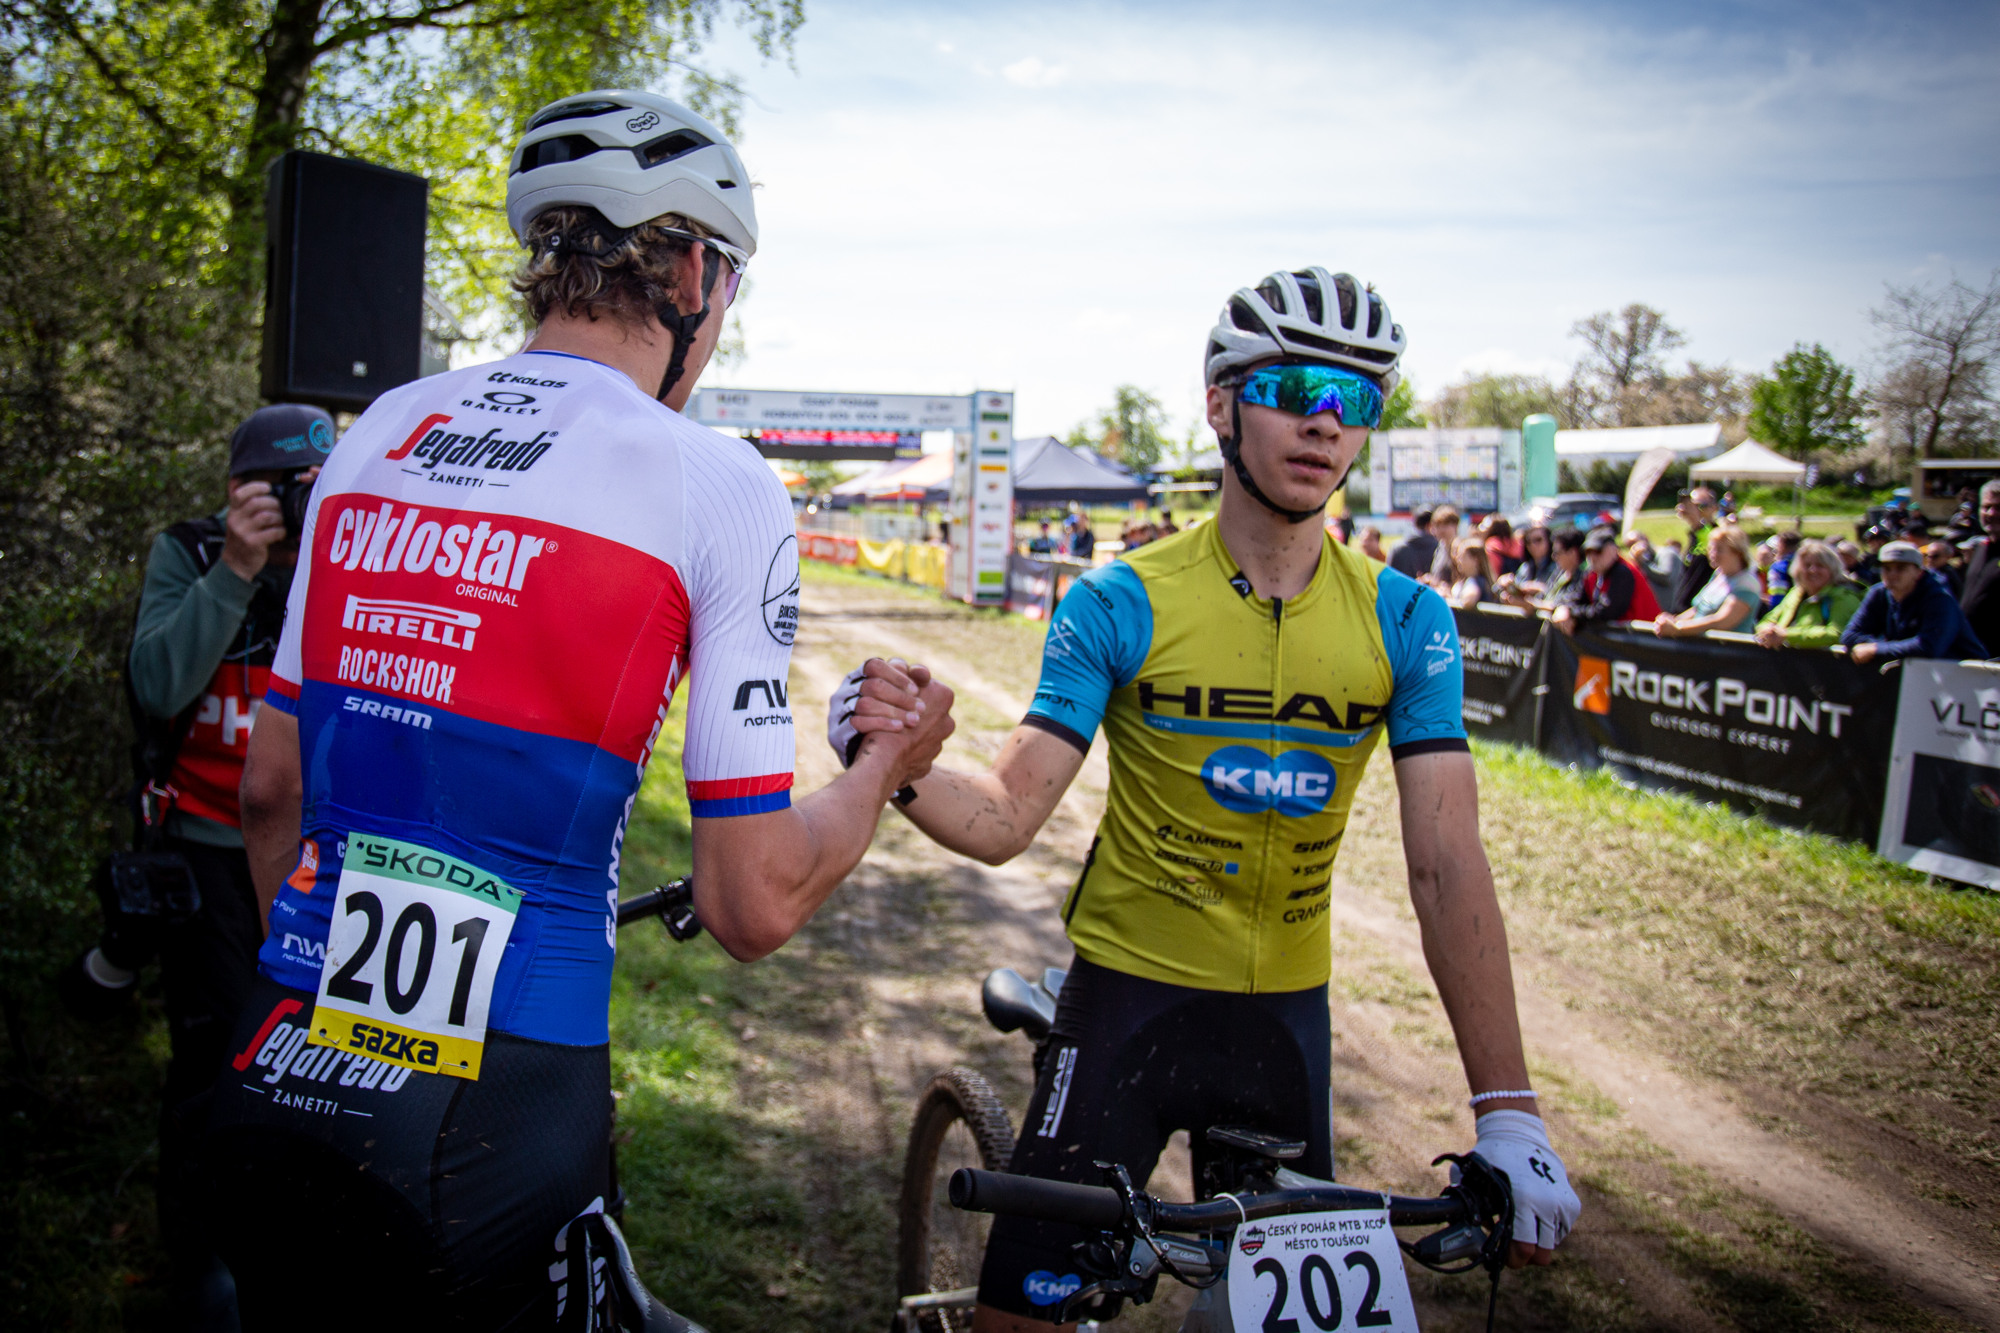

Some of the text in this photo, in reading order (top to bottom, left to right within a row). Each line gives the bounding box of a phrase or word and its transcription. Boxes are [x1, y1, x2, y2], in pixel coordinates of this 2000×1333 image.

[460, 399, 542, 416] OAKLEY
[428, 472, 485, 488] ZANETTI
[455, 583, 519, 608] ORIGINAL
[341, 594, 482, 652] PIRELLI
[337, 645, 457, 704] ROCKSHOX
[343, 696, 432, 730] SRAM
[1610, 659, 1853, 739] ROCK POINT
[1650, 711, 1792, 755] OUTDOOR EXPERT
[1212, 765, 1329, 798] KMC
[326, 890, 490, 1027] 201
[272, 1089, 339, 1116] ZANETTI
[1037, 1046, 1069, 1137] HEAD
[1267, 1222, 1298, 1237] ČESKÝ
[1300, 1219, 1337, 1234] POHÁR
[1338, 1219, 1362, 1232] MTB
[1322, 1234, 1370, 1249] TOUŠKOV
[1252, 1250, 1393, 1333] 202
